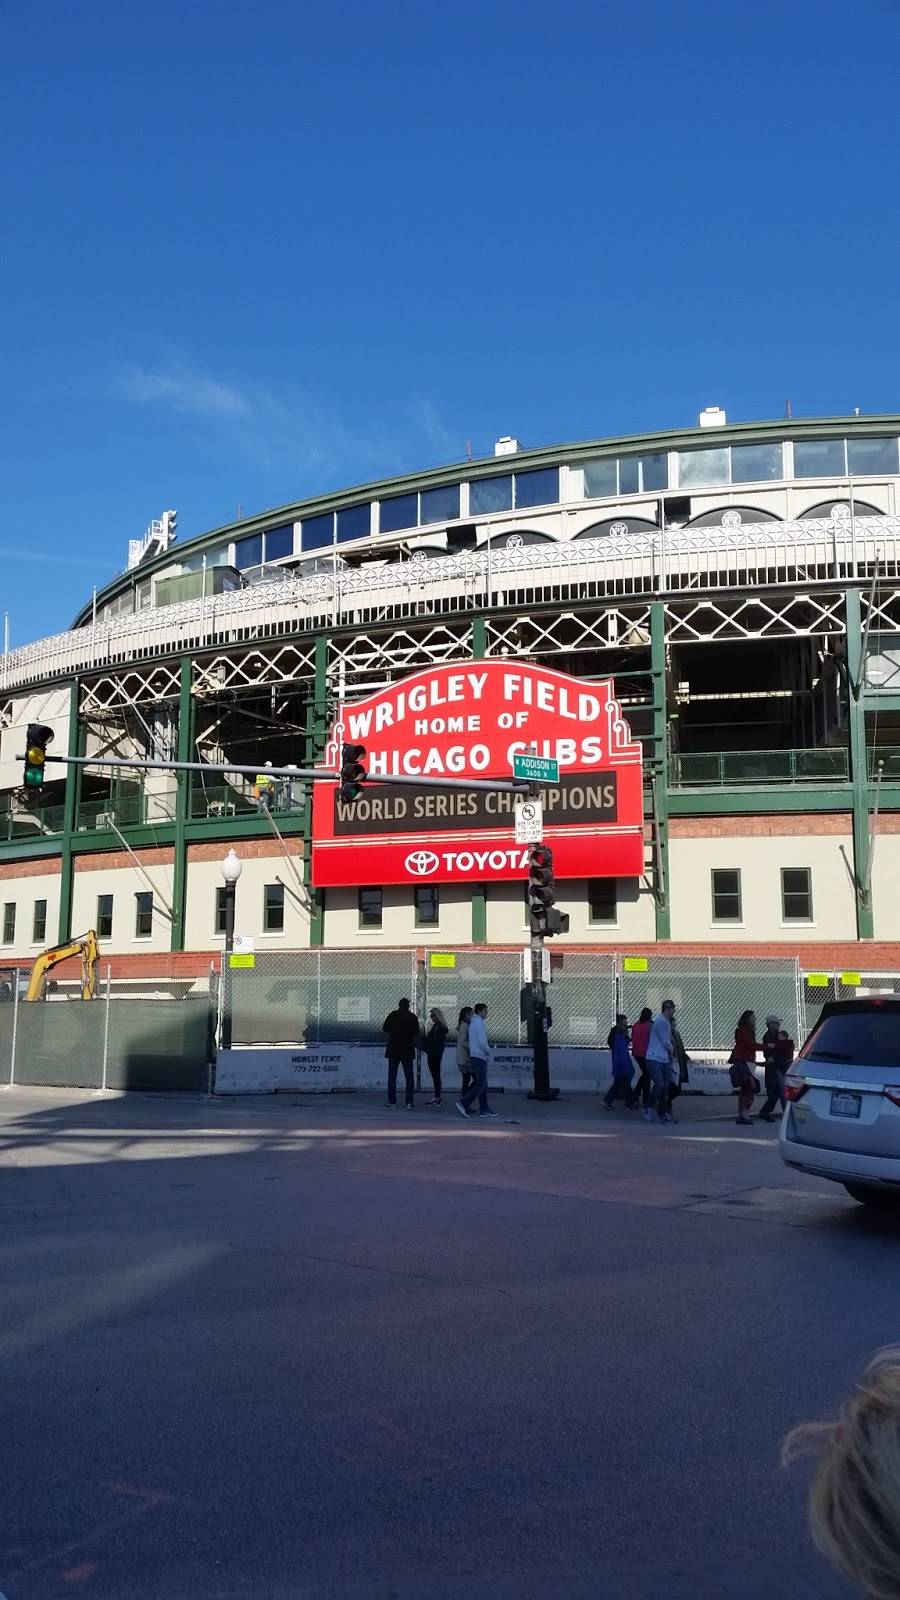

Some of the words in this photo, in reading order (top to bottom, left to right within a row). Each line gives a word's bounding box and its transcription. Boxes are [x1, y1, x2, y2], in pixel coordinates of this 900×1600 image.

[348, 672, 488, 740] WRIGLEY
[504, 673, 600, 722] FIELD
[414, 715, 481, 736] HOME
[497, 711, 529, 729] OF
[369, 743, 490, 776] HICAGO
[521, 758, 550, 770] ADDISON
[526, 769, 541, 777] 3600
[337, 797, 407, 822] WORLD
[413, 792, 478, 818] SERIES
[321, 1055, 342, 1063] FENCE
